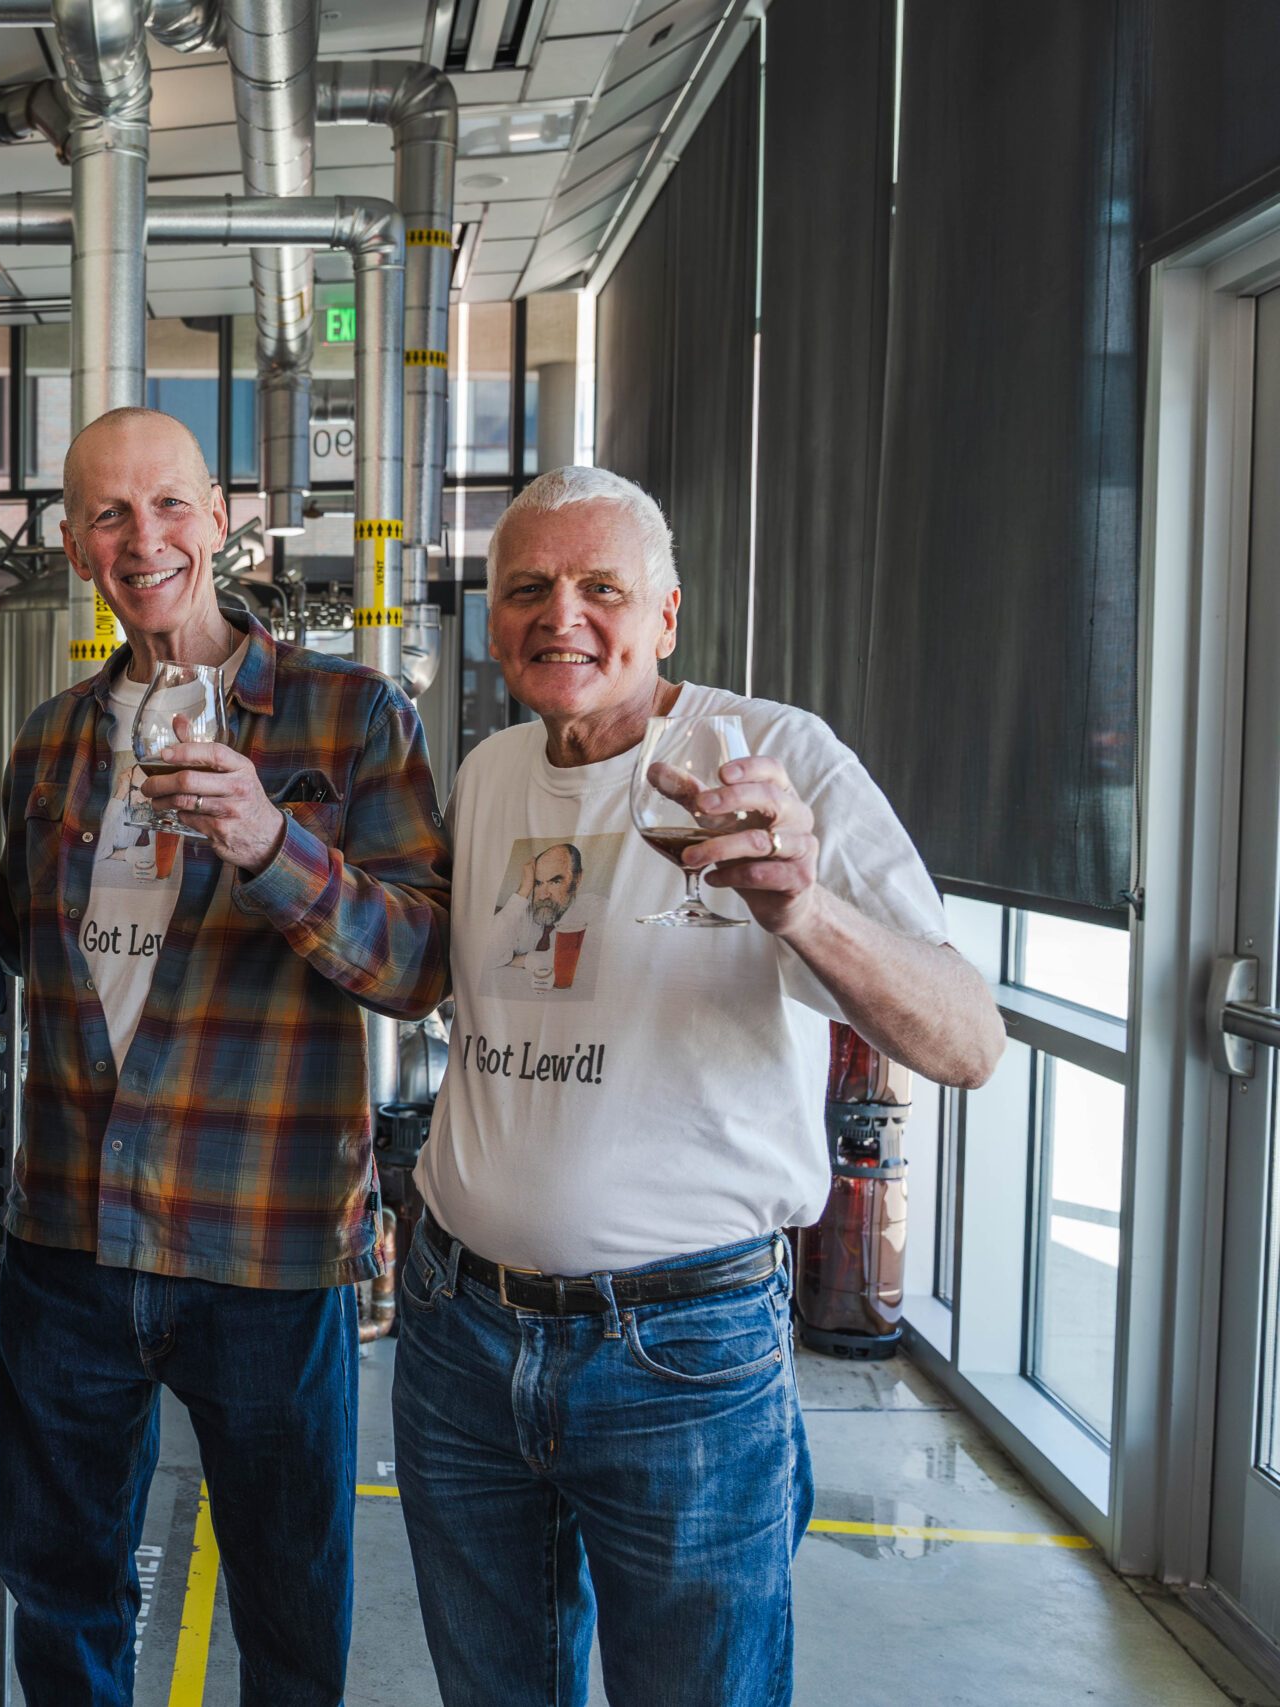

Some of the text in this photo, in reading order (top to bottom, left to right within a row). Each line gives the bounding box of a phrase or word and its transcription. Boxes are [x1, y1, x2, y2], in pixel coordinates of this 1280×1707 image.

[376, 560, 384, 586] VENT
[95, 613, 114, 636] LOW
[83, 920, 122, 955] Got
[463, 1035, 605, 1084] I Got Lew'd!
